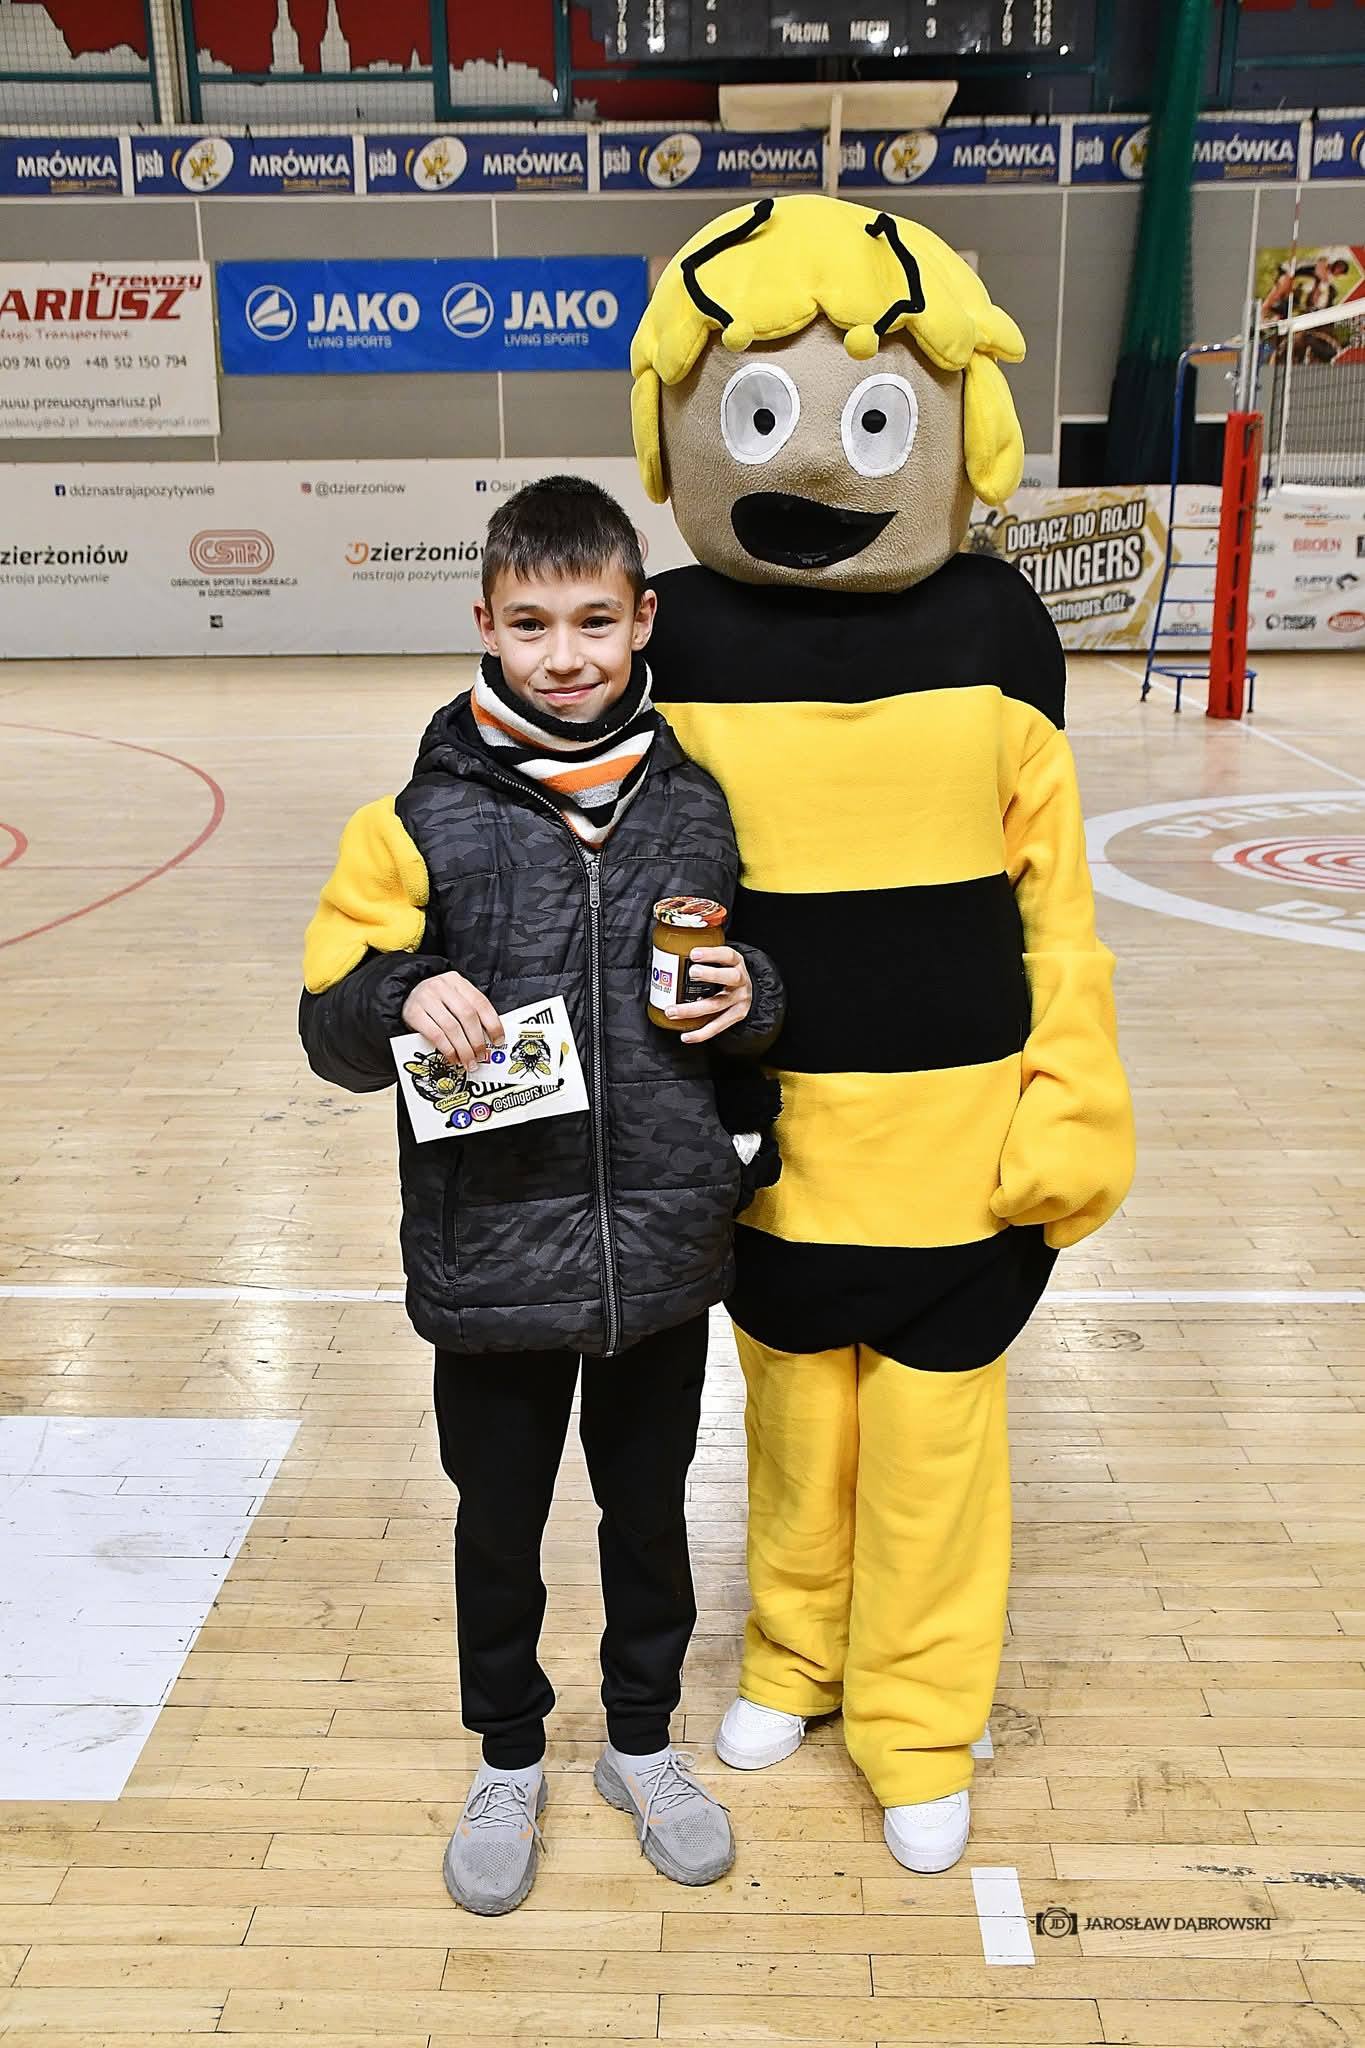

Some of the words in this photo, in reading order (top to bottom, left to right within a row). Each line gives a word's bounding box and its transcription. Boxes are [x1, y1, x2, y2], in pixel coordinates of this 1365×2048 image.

[926, 17, 937, 38] 3
[717, 144, 818, 171] MRÓWKA
[952, 139, 1056, 167] MRÓWKA
[1192, 133, 1295, 162] MRÓWKA
[17, 150, 118, 178] MRÓWKA
[250, 149, 350, 177] MRÓWKA
[483, 148, 584, 175] MRÓWKA
[90, 272, 202, 289] Przewozy
[0, 288, 184, 321] ARIUSZ
[308, 293, 420, 332] JAKO
[504, 290, 618, 330] JAKO
[308, 336, 344, 349] LIVING
[346, 335, 392, 348] SPORTS
[504, 333, 541, 347] LIVING
[544, 332, 590, 346] SPORTS
[45, 355, 70, 369] 609
[85, 355, 109, 369] +48
[114, 355, 133, 369] 512
[139, 354, 160, 368] 150
[166, 354, 188, 368] 794
[69, 484, 215, 499] ddznastrajapozytywnie
[315, 480, 406, 498] @dzierzoniow
[1007, 514, 1068, 552] DOŁĄCZ
[1073, 511, 1097, 540] DO
[1100, 501, 1144, 534] ROJU
[0, 545, 128, 566] zierżoniów
[344, 540, 486, 564] Dzierżonió
[352, 569, 404, 581] nastraja
[407, 568, 480, 582] pozytywnie
[1019, 534, 1142, 595] STINGERS
[37, 572, 110, 586] pozytywnie
